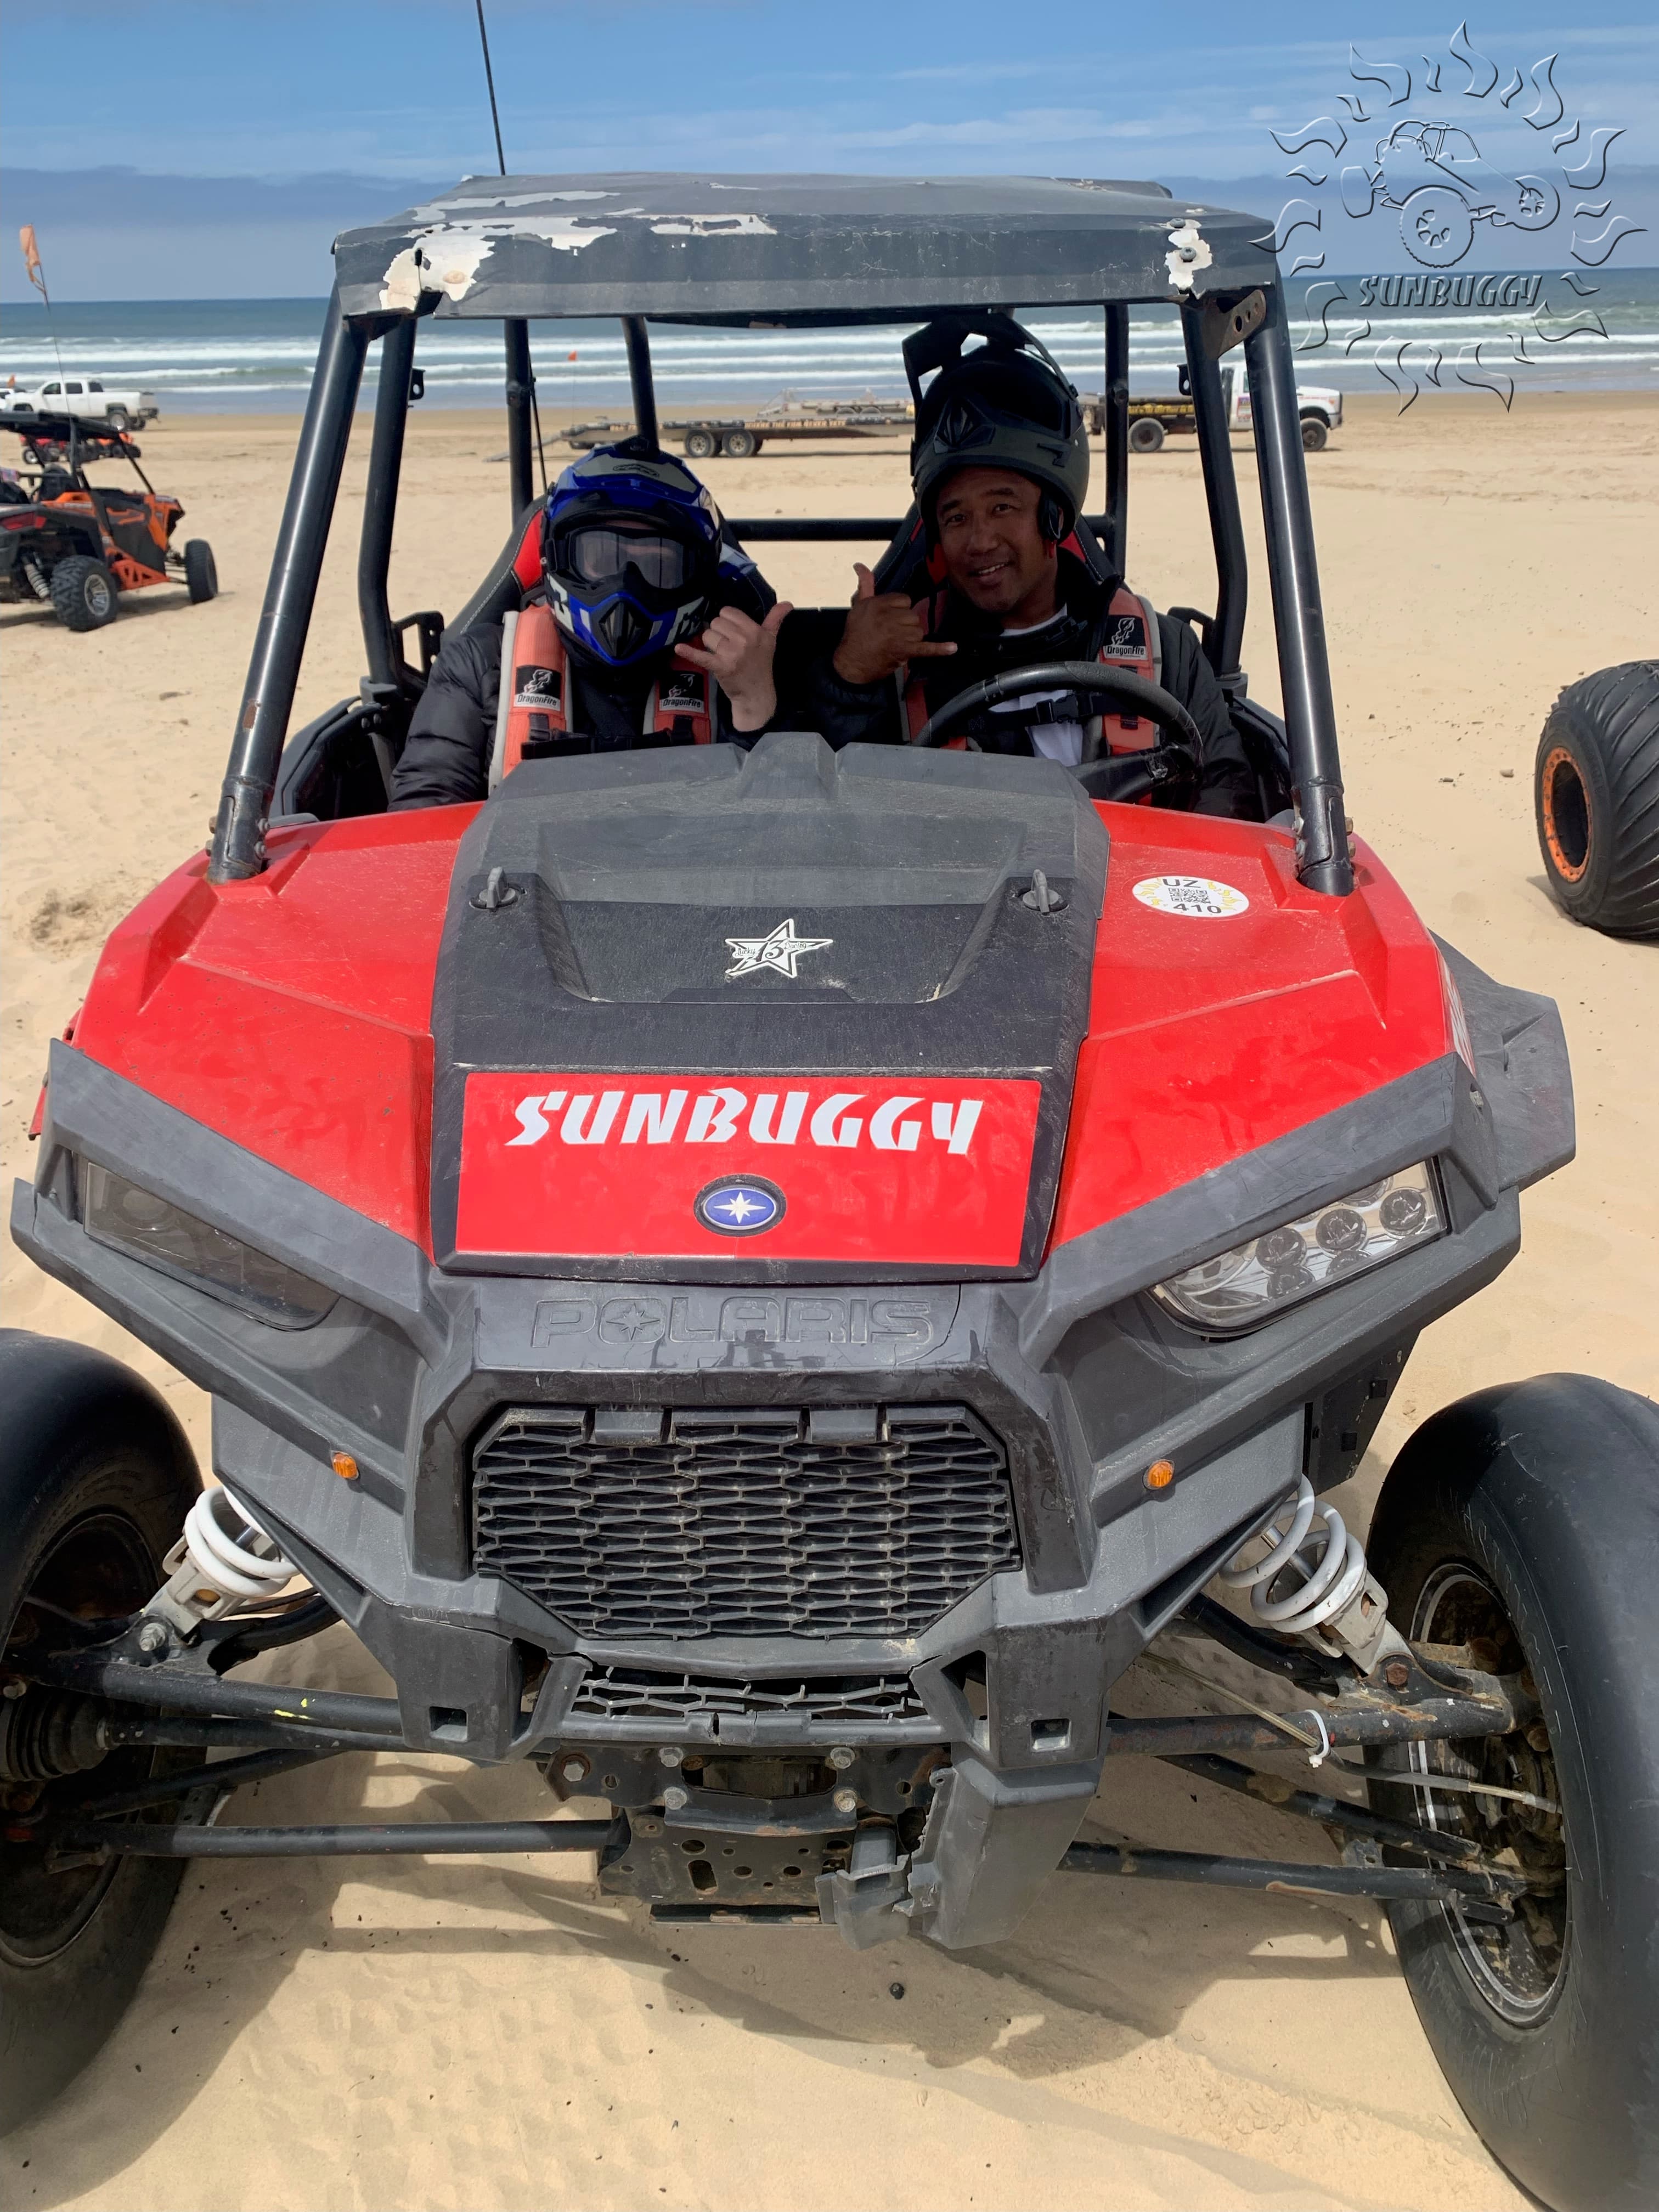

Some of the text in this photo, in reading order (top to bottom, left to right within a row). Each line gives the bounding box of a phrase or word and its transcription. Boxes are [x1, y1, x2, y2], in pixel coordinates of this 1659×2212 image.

[1107, 646, 1144, 655] DragonFire
[517, 694, 557, 707] DragonFire
[662, 697, 701, 709] DragonFire
[1162, 878, 1201, 888] UZ
[1173, 903, 1222, 914] 410
[735, 947, 756, 956] Lucky
[755, 938, 788, 962] 13
[504, 1087, 984, 1155] SUNBUGGY
[531, 1296, 934, 1348] POLARIS
